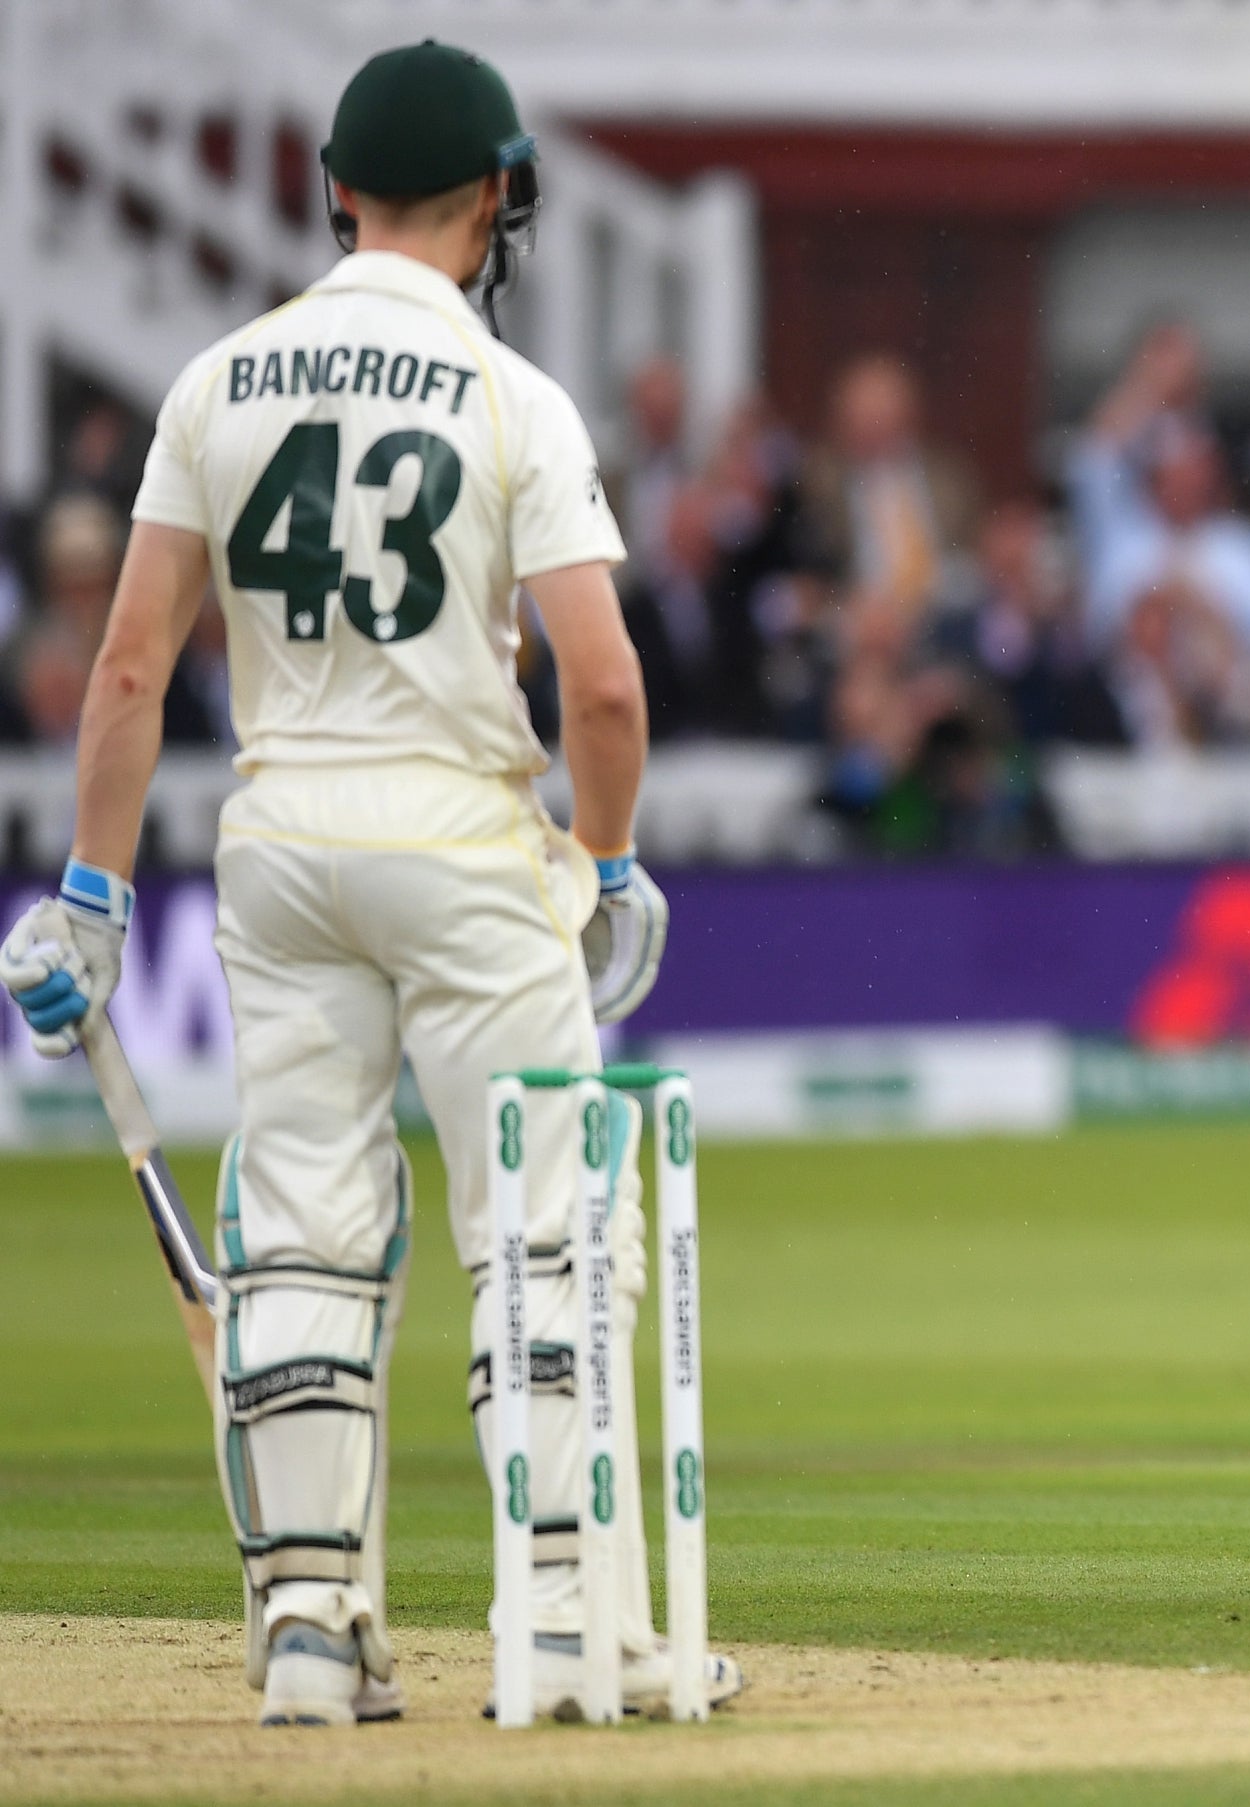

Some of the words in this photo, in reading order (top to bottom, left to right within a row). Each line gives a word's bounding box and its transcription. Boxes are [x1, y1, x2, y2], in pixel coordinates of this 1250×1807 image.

[227, 347, 478, 415] BANCROFT
[227, 421, 463, 643] 43
[586, 1195, 608, 1247] The
[590, 1254, 616, 1313] Test
[590, 1322, 613, 1432] Experts
